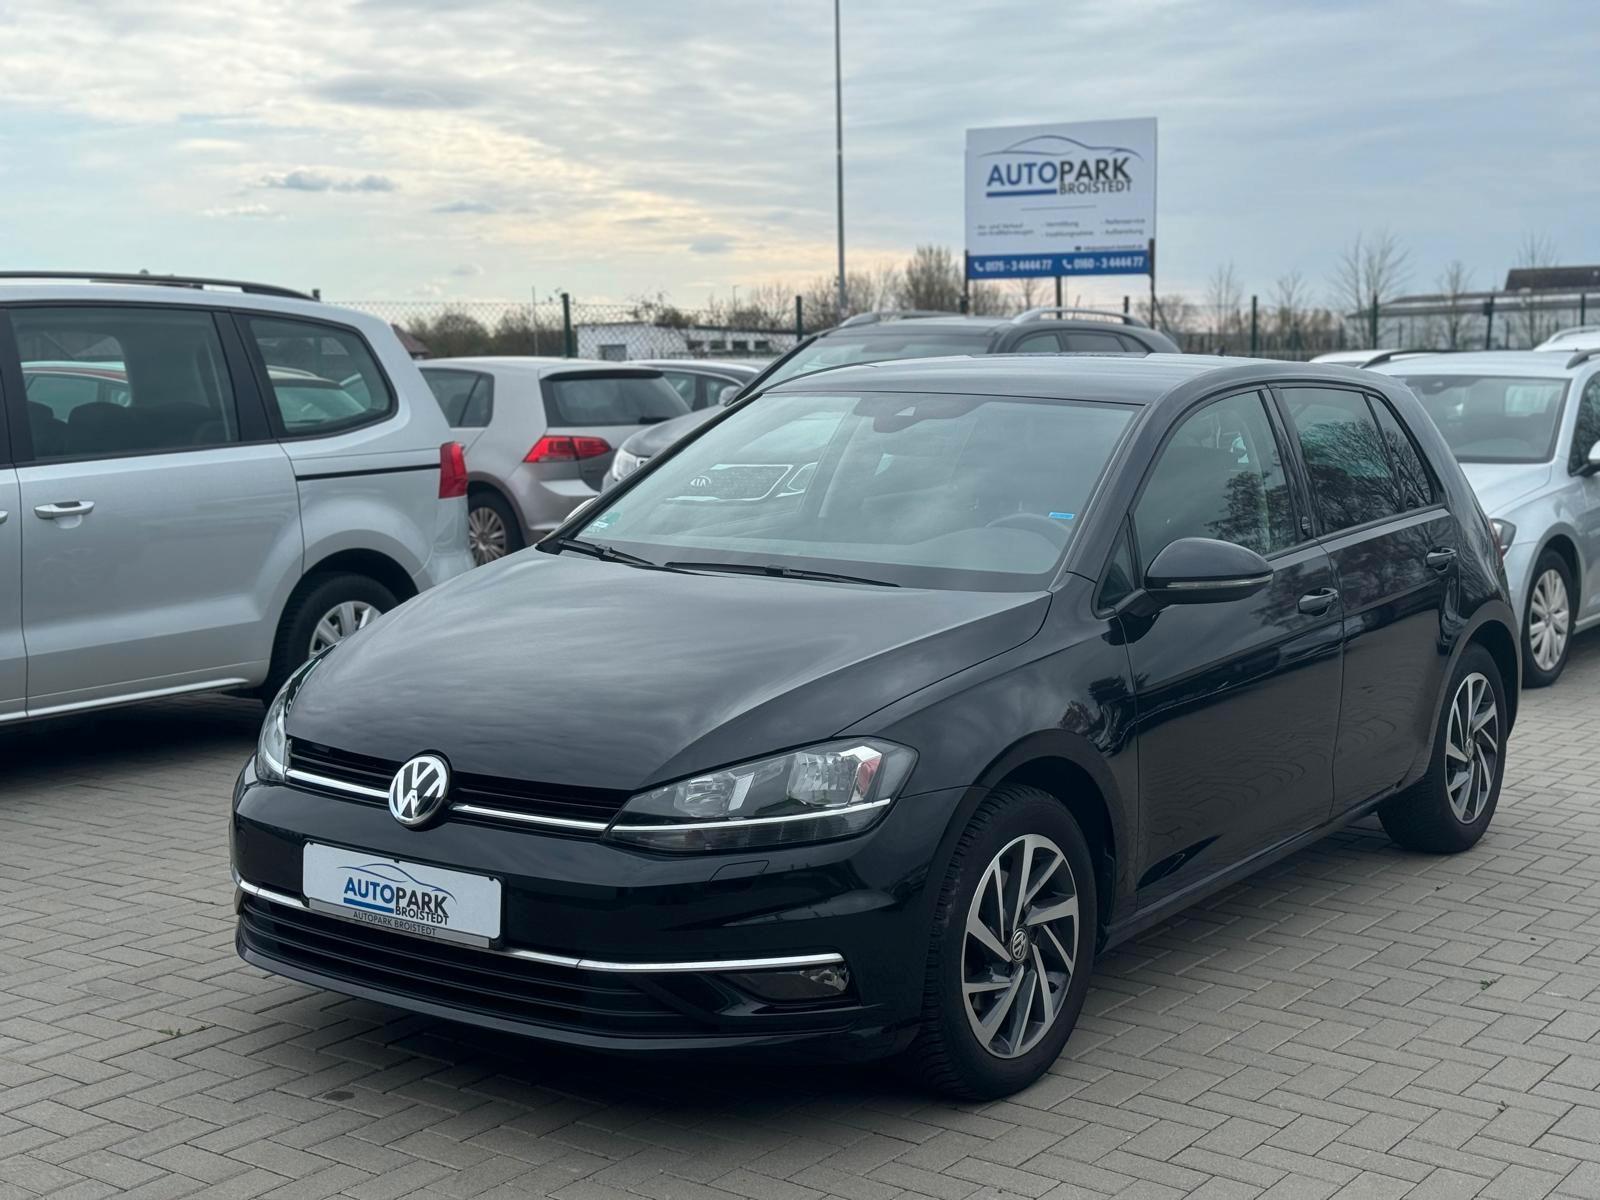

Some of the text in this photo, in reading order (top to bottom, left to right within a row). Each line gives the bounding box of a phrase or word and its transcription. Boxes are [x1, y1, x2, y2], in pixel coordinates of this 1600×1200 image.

[987, 157, 1131, 187] AUTOPARK
[1059, 179, 1132, 195] BROISTEDT
[389, 756, 448, 826] VW
[344, 877, 449, 916] AUTOPARK
[353, 911, 437, 936] AUTOPARK BROISTEDT
[395, 905, 450, 926] BROISTEDT
